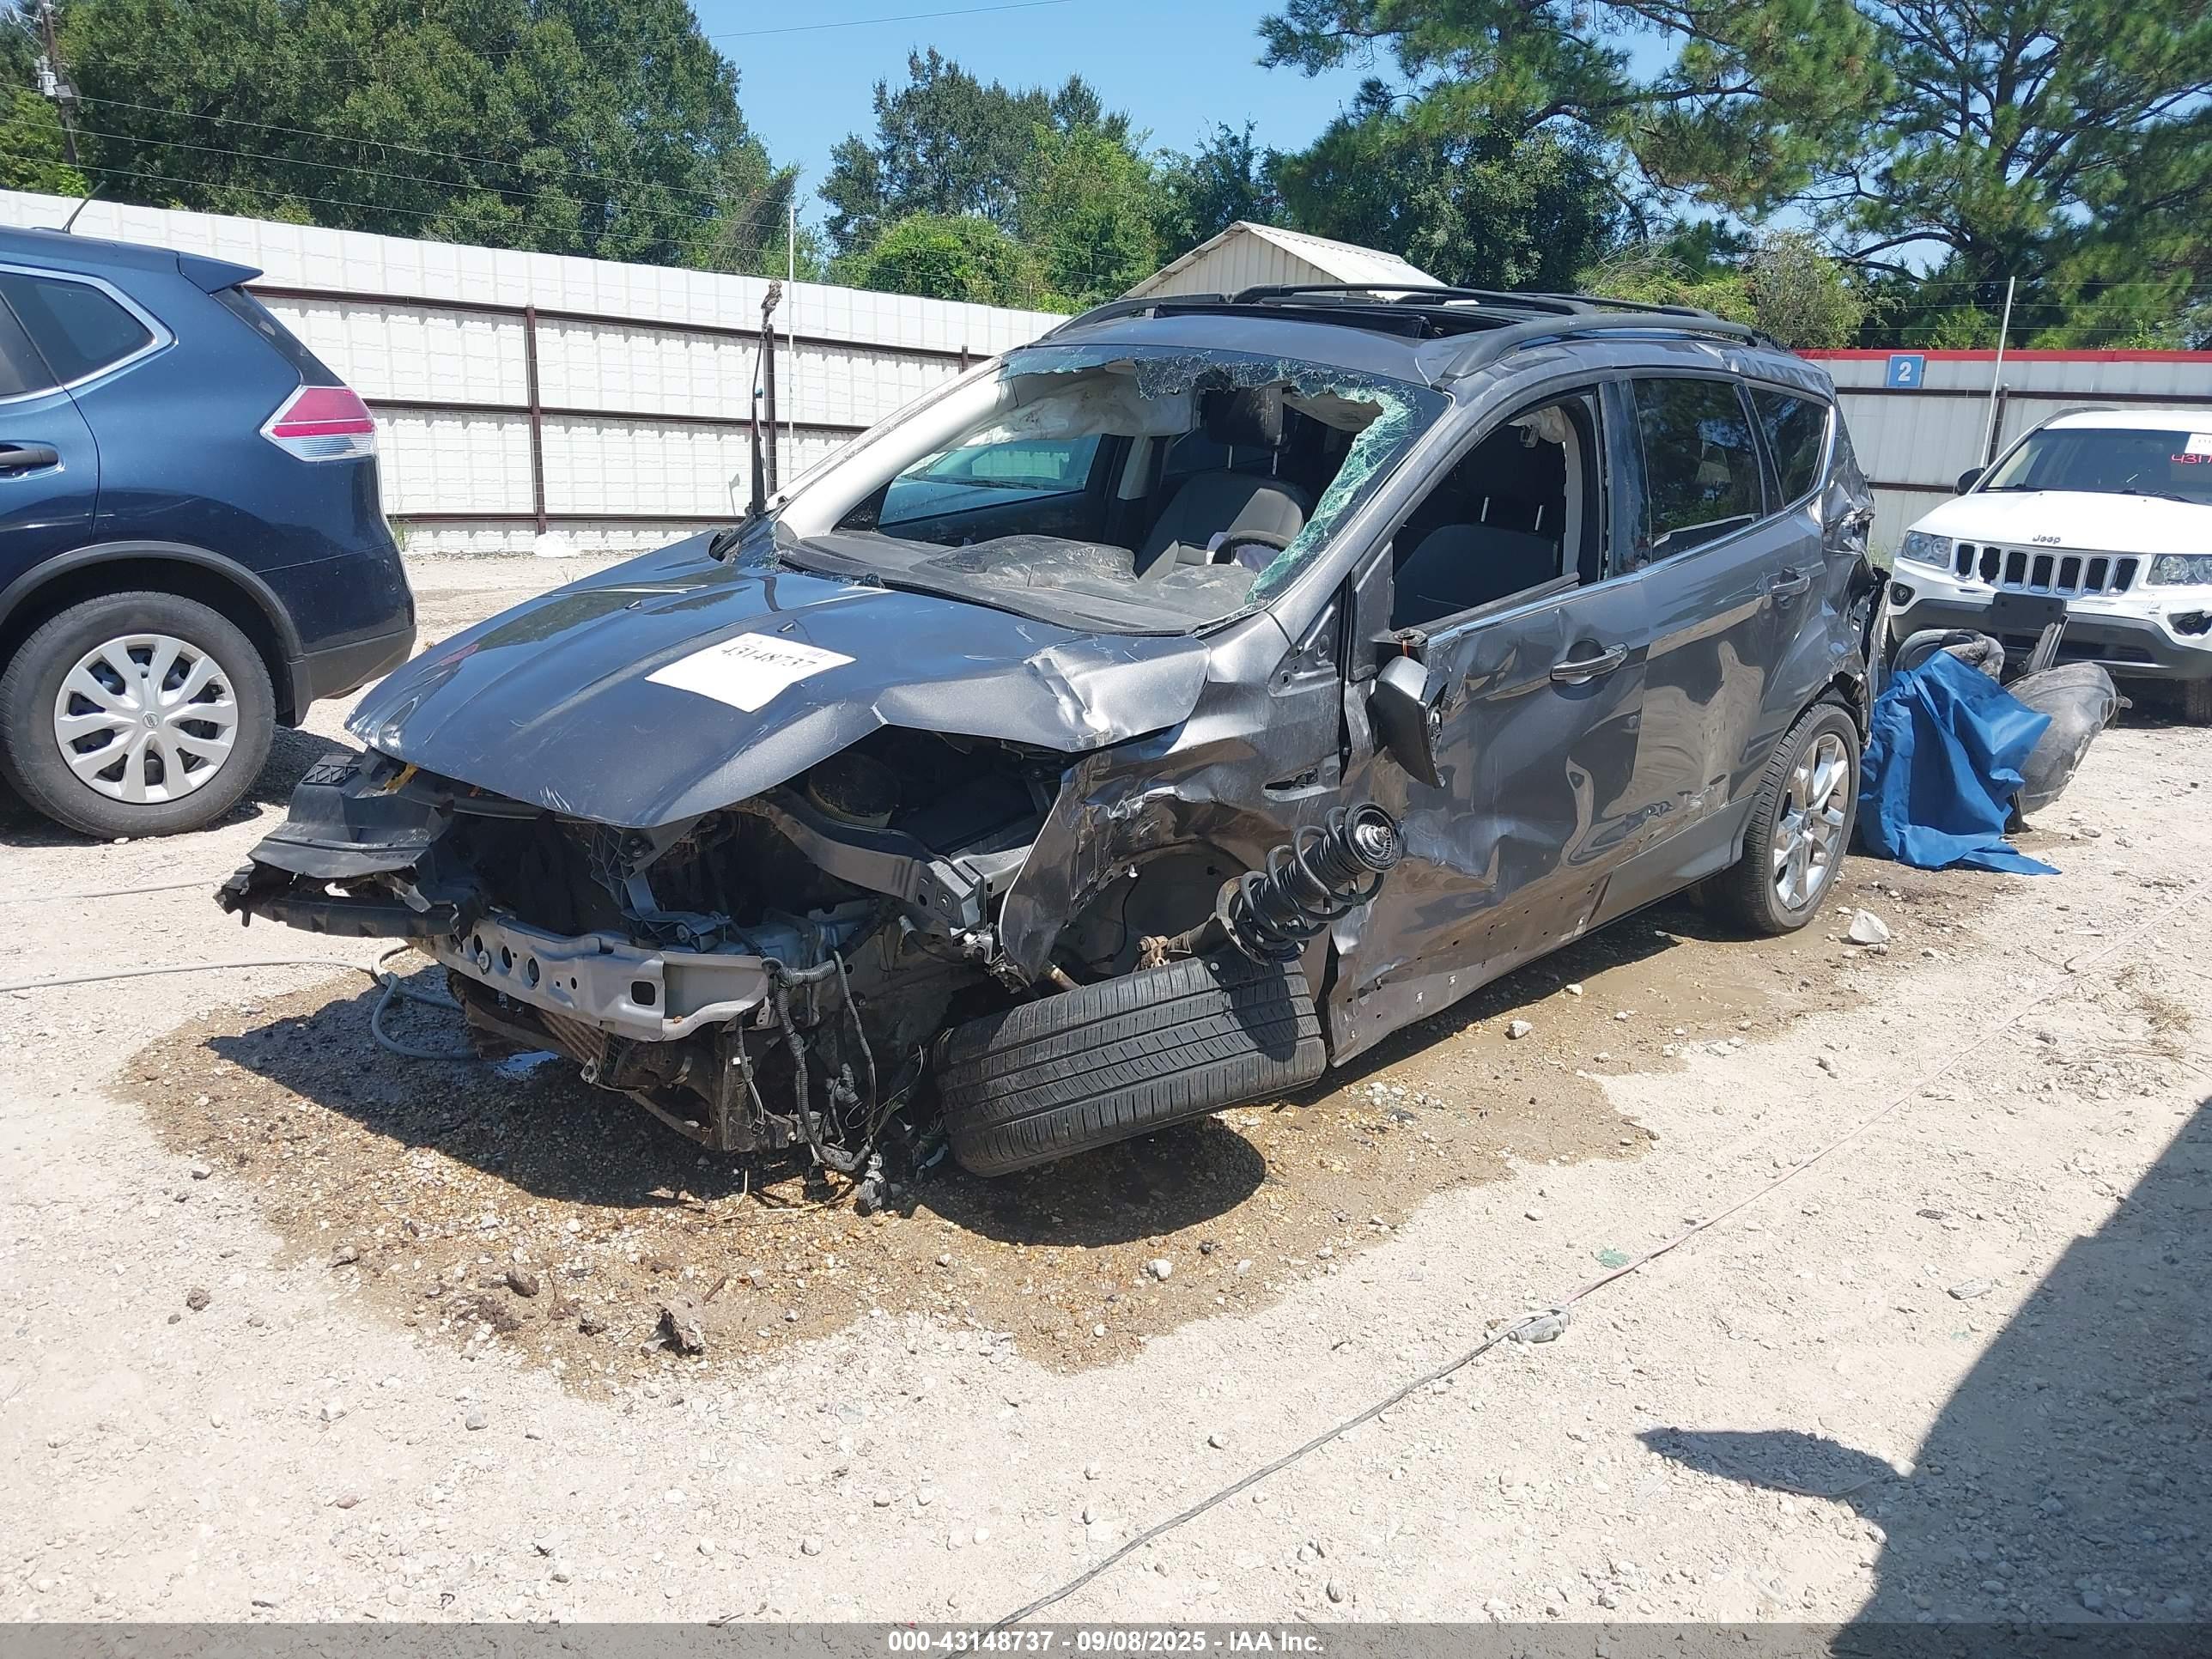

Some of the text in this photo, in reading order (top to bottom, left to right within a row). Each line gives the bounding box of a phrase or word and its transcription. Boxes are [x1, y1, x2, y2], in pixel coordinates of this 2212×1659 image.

[1898, 362, 1912, 381] 2
[2032, 534, 2062, 544] Jeep
[721, 645, 817, 669] 43148737
